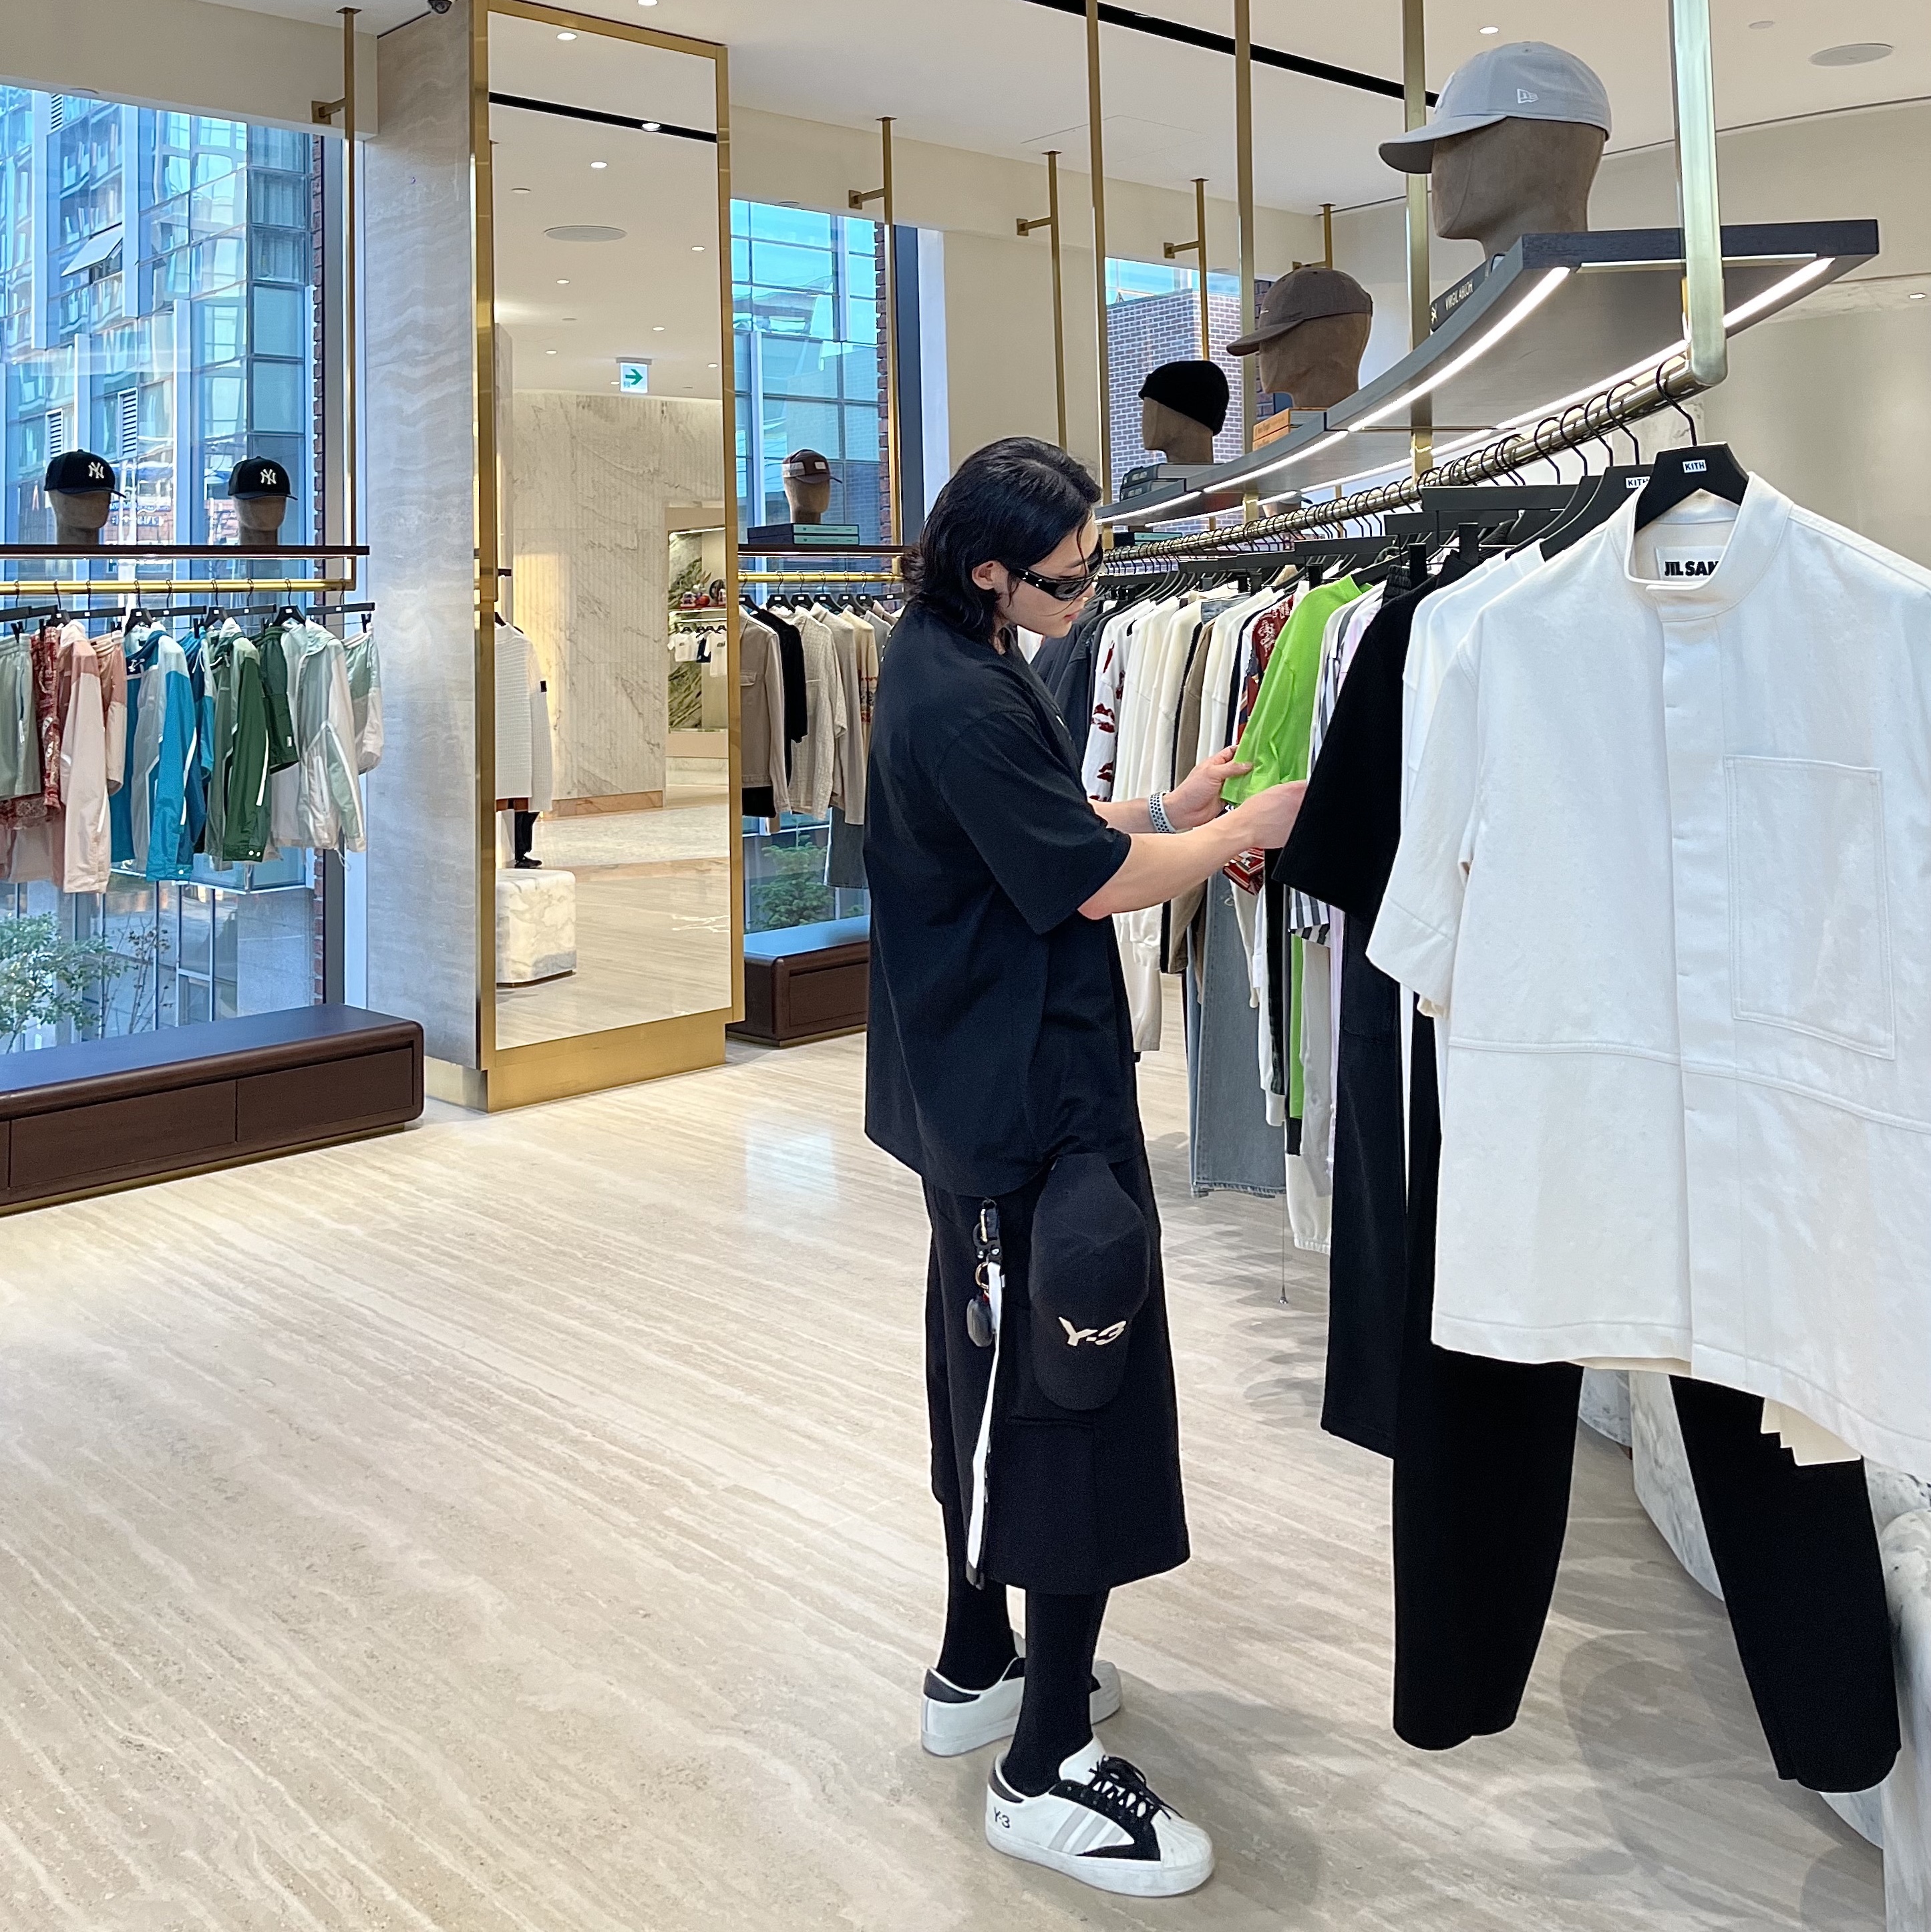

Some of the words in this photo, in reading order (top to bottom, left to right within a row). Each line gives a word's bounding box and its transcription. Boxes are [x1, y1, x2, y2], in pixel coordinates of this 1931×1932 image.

[88, 462, 104, 479] NY
[1685, 462, 1705, 471] KITH
[260, 468, 277, 484] NY
[1664, 560, 1684, 576] JIL
[1058, 1316, 1127, 1347] Y-3
[993, 1806, 1011, 1828] Y-3
